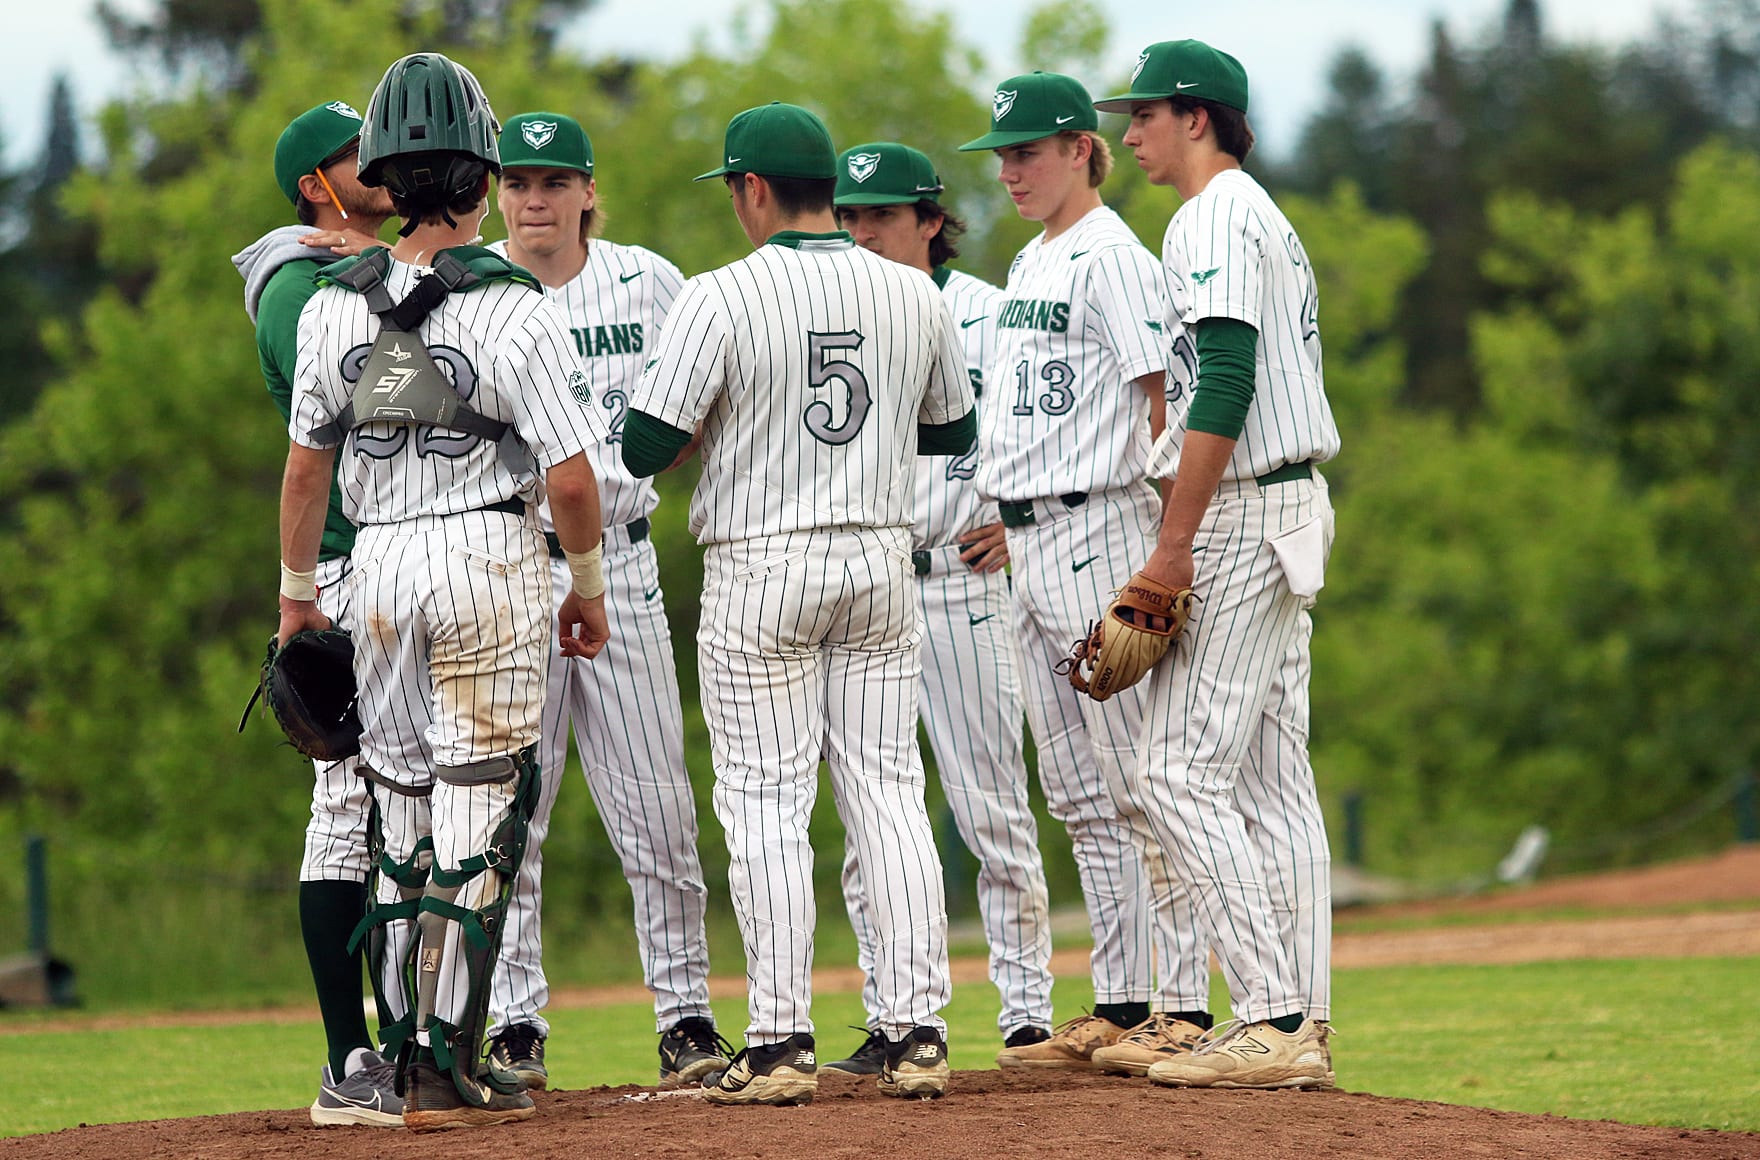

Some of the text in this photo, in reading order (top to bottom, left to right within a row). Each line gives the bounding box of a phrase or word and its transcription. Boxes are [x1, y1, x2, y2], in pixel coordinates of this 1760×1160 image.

[804, 328, 873, 446] 5
[1013, 360, 1076, 416] 13
[1128, 586, 1163, 606] Wilson
